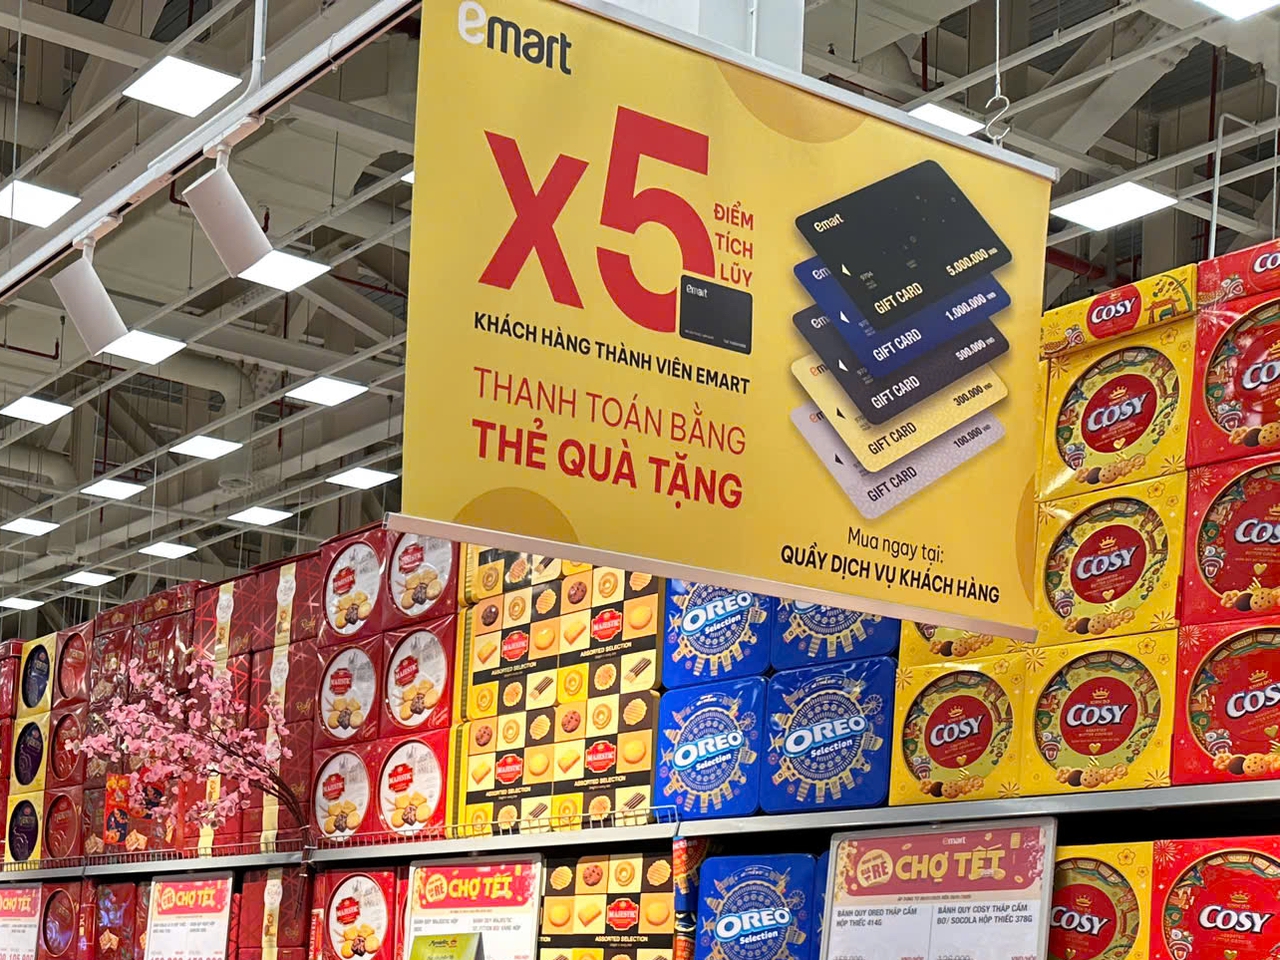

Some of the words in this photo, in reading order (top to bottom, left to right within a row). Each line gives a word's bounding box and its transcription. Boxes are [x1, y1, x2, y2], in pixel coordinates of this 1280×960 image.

[458, 1, 572, 76] emart
[713, 201, 754, 230] ĐIỂM
[814, 213, 844, 233] emart
[714, 231, 753, 260] TÍCH
[720, 262, 753, 287] LŨY
[946, 248, 989, 277] 5.000.000
[686, 284, 708, 298] emart
[874, 296, 898, 315] GIFT
[895, 282, 923, 303] CARD
[945, 293, 987, 321] 1.000.000
[1090, 296, 1137, 325] COSY
[474, 311, 537, 343] KHÁCH
[541, 326, 591, 355] HÀNG
[595, 341, 652, 371] THÀNH
[656, 356, 692, 382] VIÊN
[696, 367, 750, 394] EMART
[873, 342, 897, 361] GIFT
[894, 328, 921, 350] CARD
[955, 339, 987, 361] 500.000
[871, 389, 894, 409] GIFT
[892, 375, 920, 397] CARD
[953, 385, 984, 407] 300.000
[473, 366, 576, 418] THANH
[586, 393, 662, 437] TOÁN
[670, 402, 746, 455] BẰNG
[1086, 394, 1146, 434] COSY
[868, 435, 891, 455] GIFT
[889, 421, 917, 443] CARD
[953, 426, 983, 449] 100.000
[472, 417, 547, 470] THẺ
[557, 438, 637, 489] QUÀ
[649, 452, 743, 509] TẶNG
[867, 482, 891, 502] GIFT
[889, 466, 917, 489] CARD
[847, 527, 878, 550] Mua
[883, 536, 918, 560] ngay
[922, 544, 944, 565] tại:
[780, 542, 827, 570] QUẦY
[830, 554, 870, 580] DỊCH
[875, 562, 896, 588] VỤ
[899, 568, 953, 595] KHÁCH
[956, 576, 1000, 604] HÀNG
[1067, 702, 1128, 730] COSY
[785, 717, 866, 755] OREO
[810, 738, 853, 758] Selection
[942, 836, 967, 845] emart
[895, 851, 950, 883] CHỢ
[953, 844, 1006, 880] TẾT
[449, 876, 481, 900] CHỢ
[484, 872, 513, 899] TẾT
[716, 907, 790, 939] OREO
[836, 918, 849, 928] HỘP
[849, 917, 866, 927] THIẾC
[837, 907, 854, 917] BÁNH
[854, 908, 867, 917] QUY
[868, 908, 884, 916] OREO
[938, 905, 956, 914] BÁNH
[957, 905, 973, 914] QUY
[975, 904, 990, 913] COSY
[951, 915, 977, 924] SOCOLA
[979, 914, 993, 924] HỘP
[994, 913, 1014, 923] THIẾC
[1015, 914, 1033, 923] 378G
[1199, 905, 1273, 933] COSY
[739, 930, 779, 945] Selection
